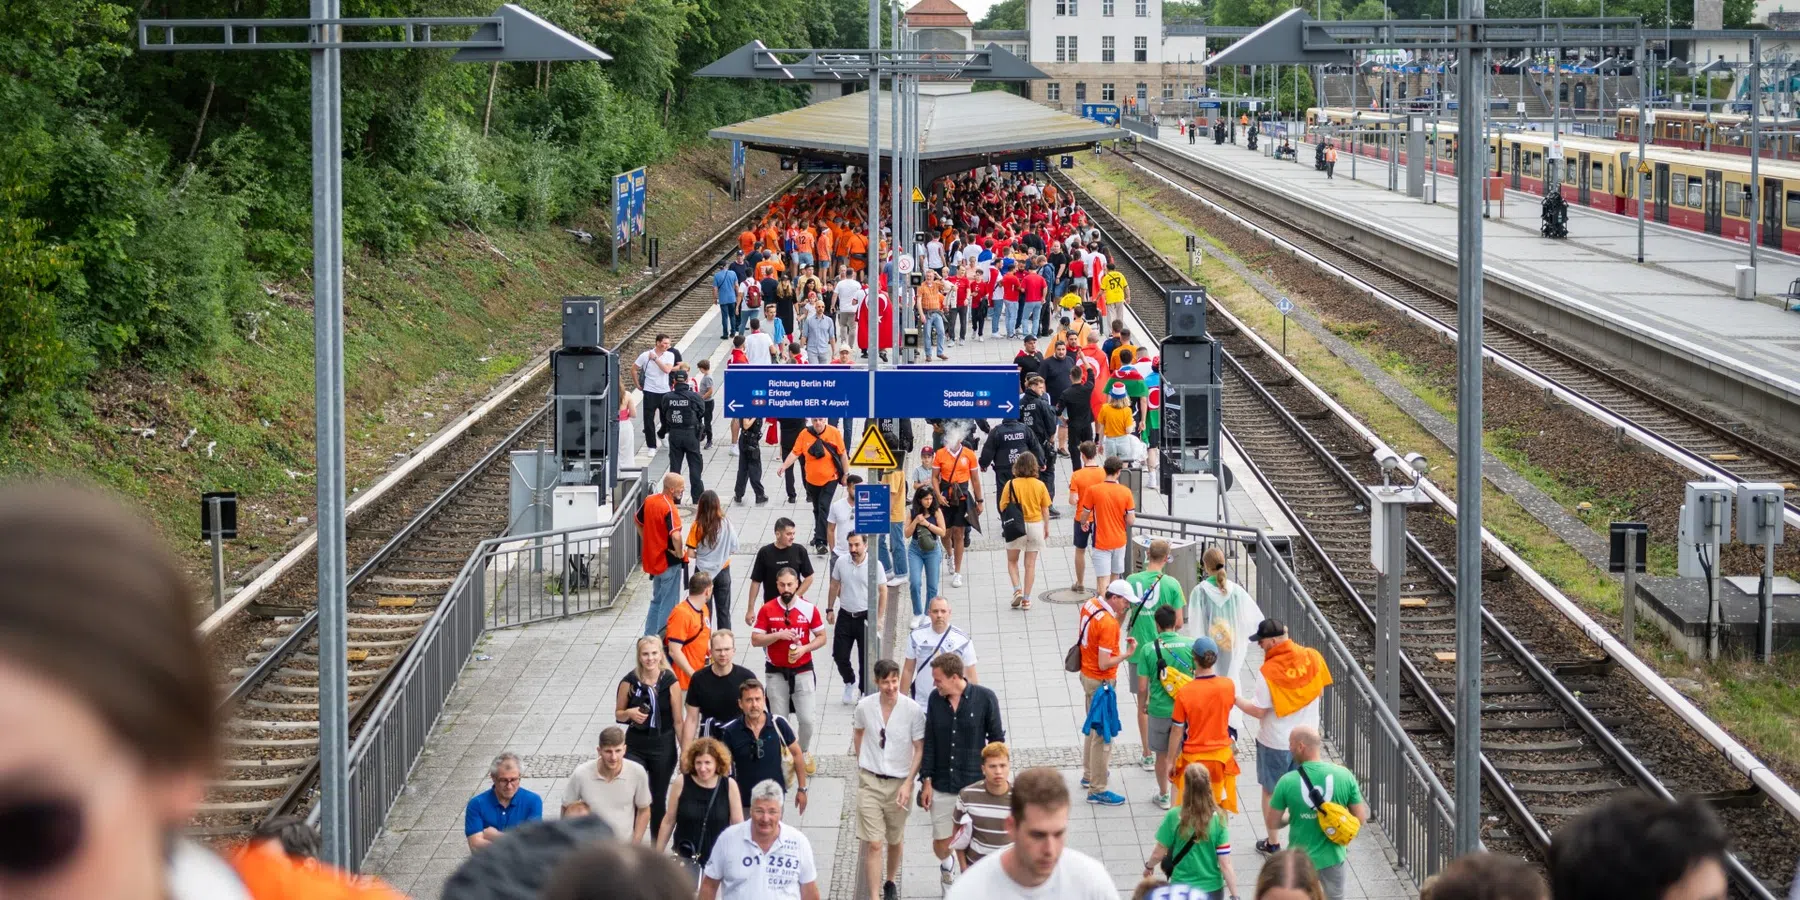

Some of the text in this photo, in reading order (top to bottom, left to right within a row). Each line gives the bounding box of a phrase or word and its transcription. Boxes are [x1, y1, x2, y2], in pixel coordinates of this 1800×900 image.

[1062, 157, 1068, 165] 2
[798, 235, 806, 244] 12
[768, 379, 836, 389] Richtung Berlin Hbf
[768, 389, 792, 397] Erkner
[943, 389, 974, 399] Spandau
[669, 399, 689, 407] POLIZEI
[768, 399, 803, 408] Flughafen
[804, 399, 820, 407] BER
[828, 399, 850, 408] Airport
[943, 399, 974, 408] Spandau
[1004, 432, 1024, 441] POLIZEI
[768, 855, 800, 870] 2563
